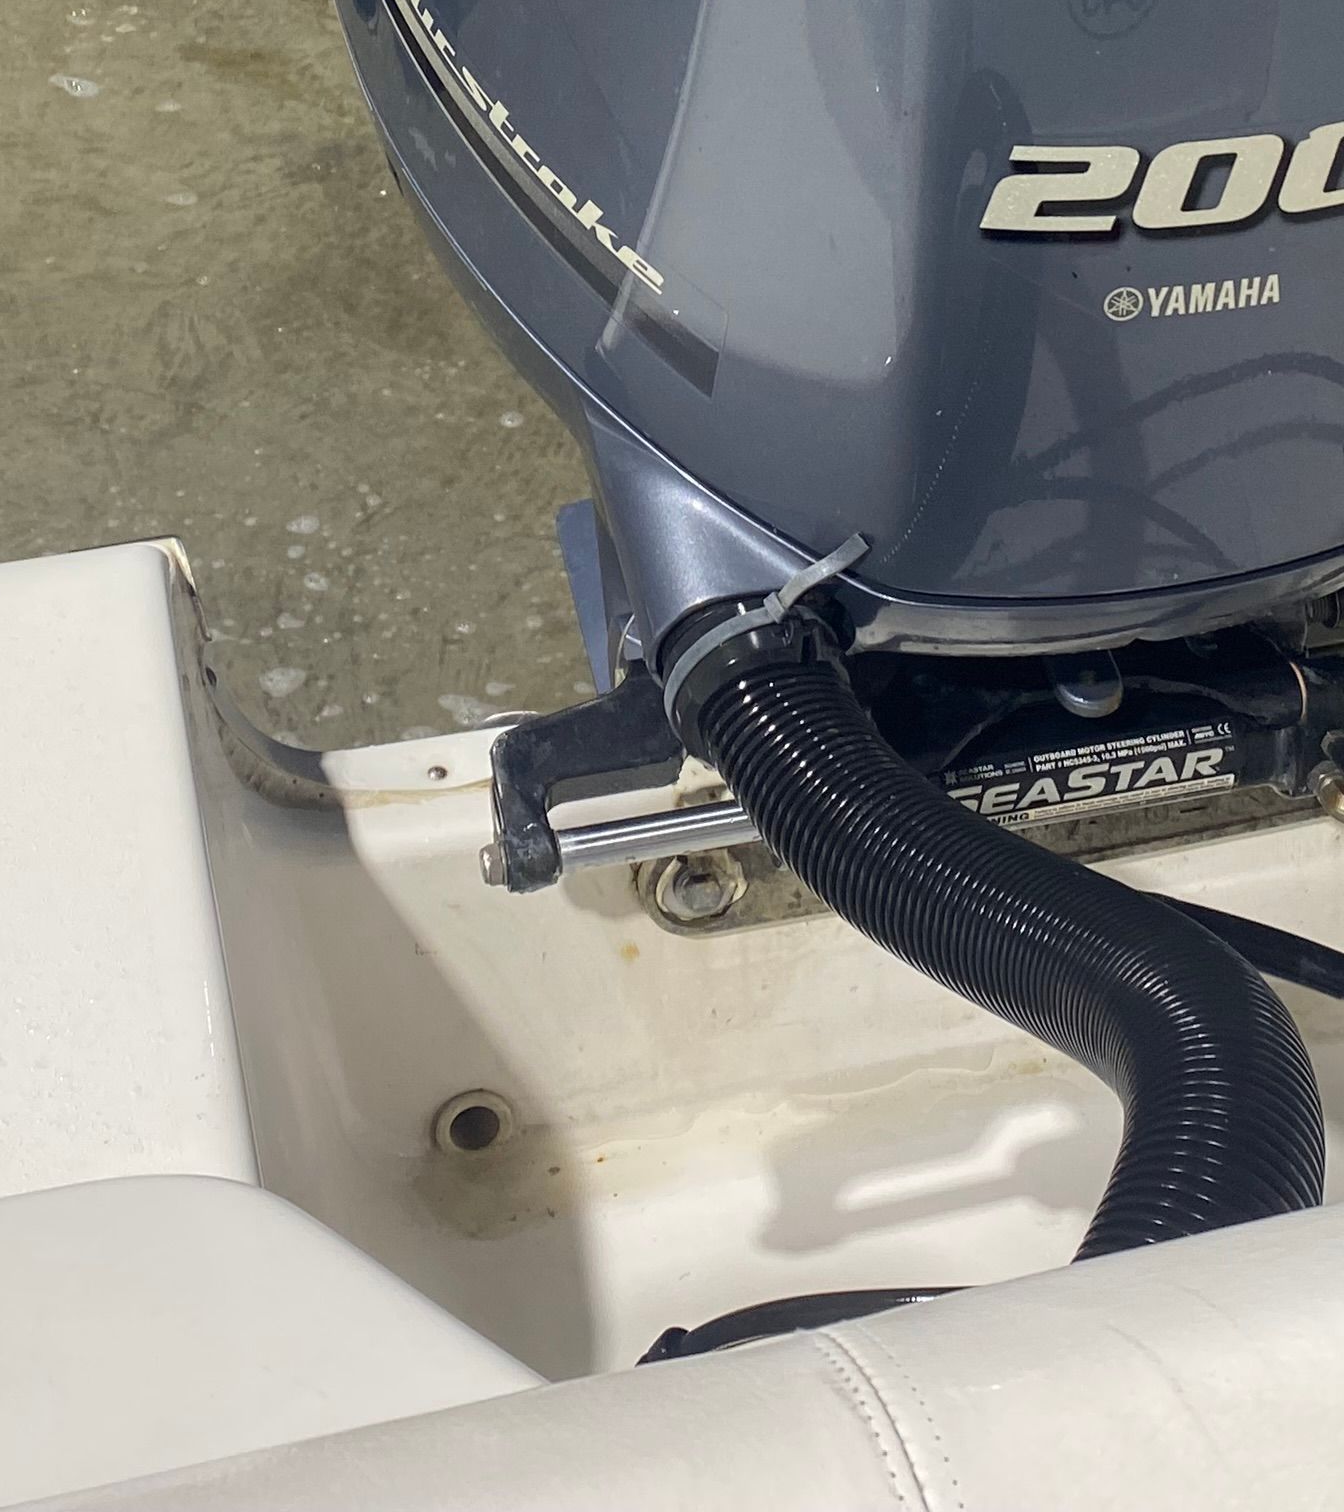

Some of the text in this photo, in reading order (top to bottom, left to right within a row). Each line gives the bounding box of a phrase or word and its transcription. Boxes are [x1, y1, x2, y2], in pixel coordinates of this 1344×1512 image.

[1148, 273, 1281, 319] YAMAHA
[1033, 748, 1076, 763] OUTBOARD
[1077, 743, 1106, 756] MOTOR
[1106, 737, 1145, 751] STEERING
[1145, 729, 1185, 744] CYLINDER
[1035, 760, 1056, 773] PART
[1167, 738, 1187, 750] MAX.
[946, 747, 1224, 815] SEASTAR
